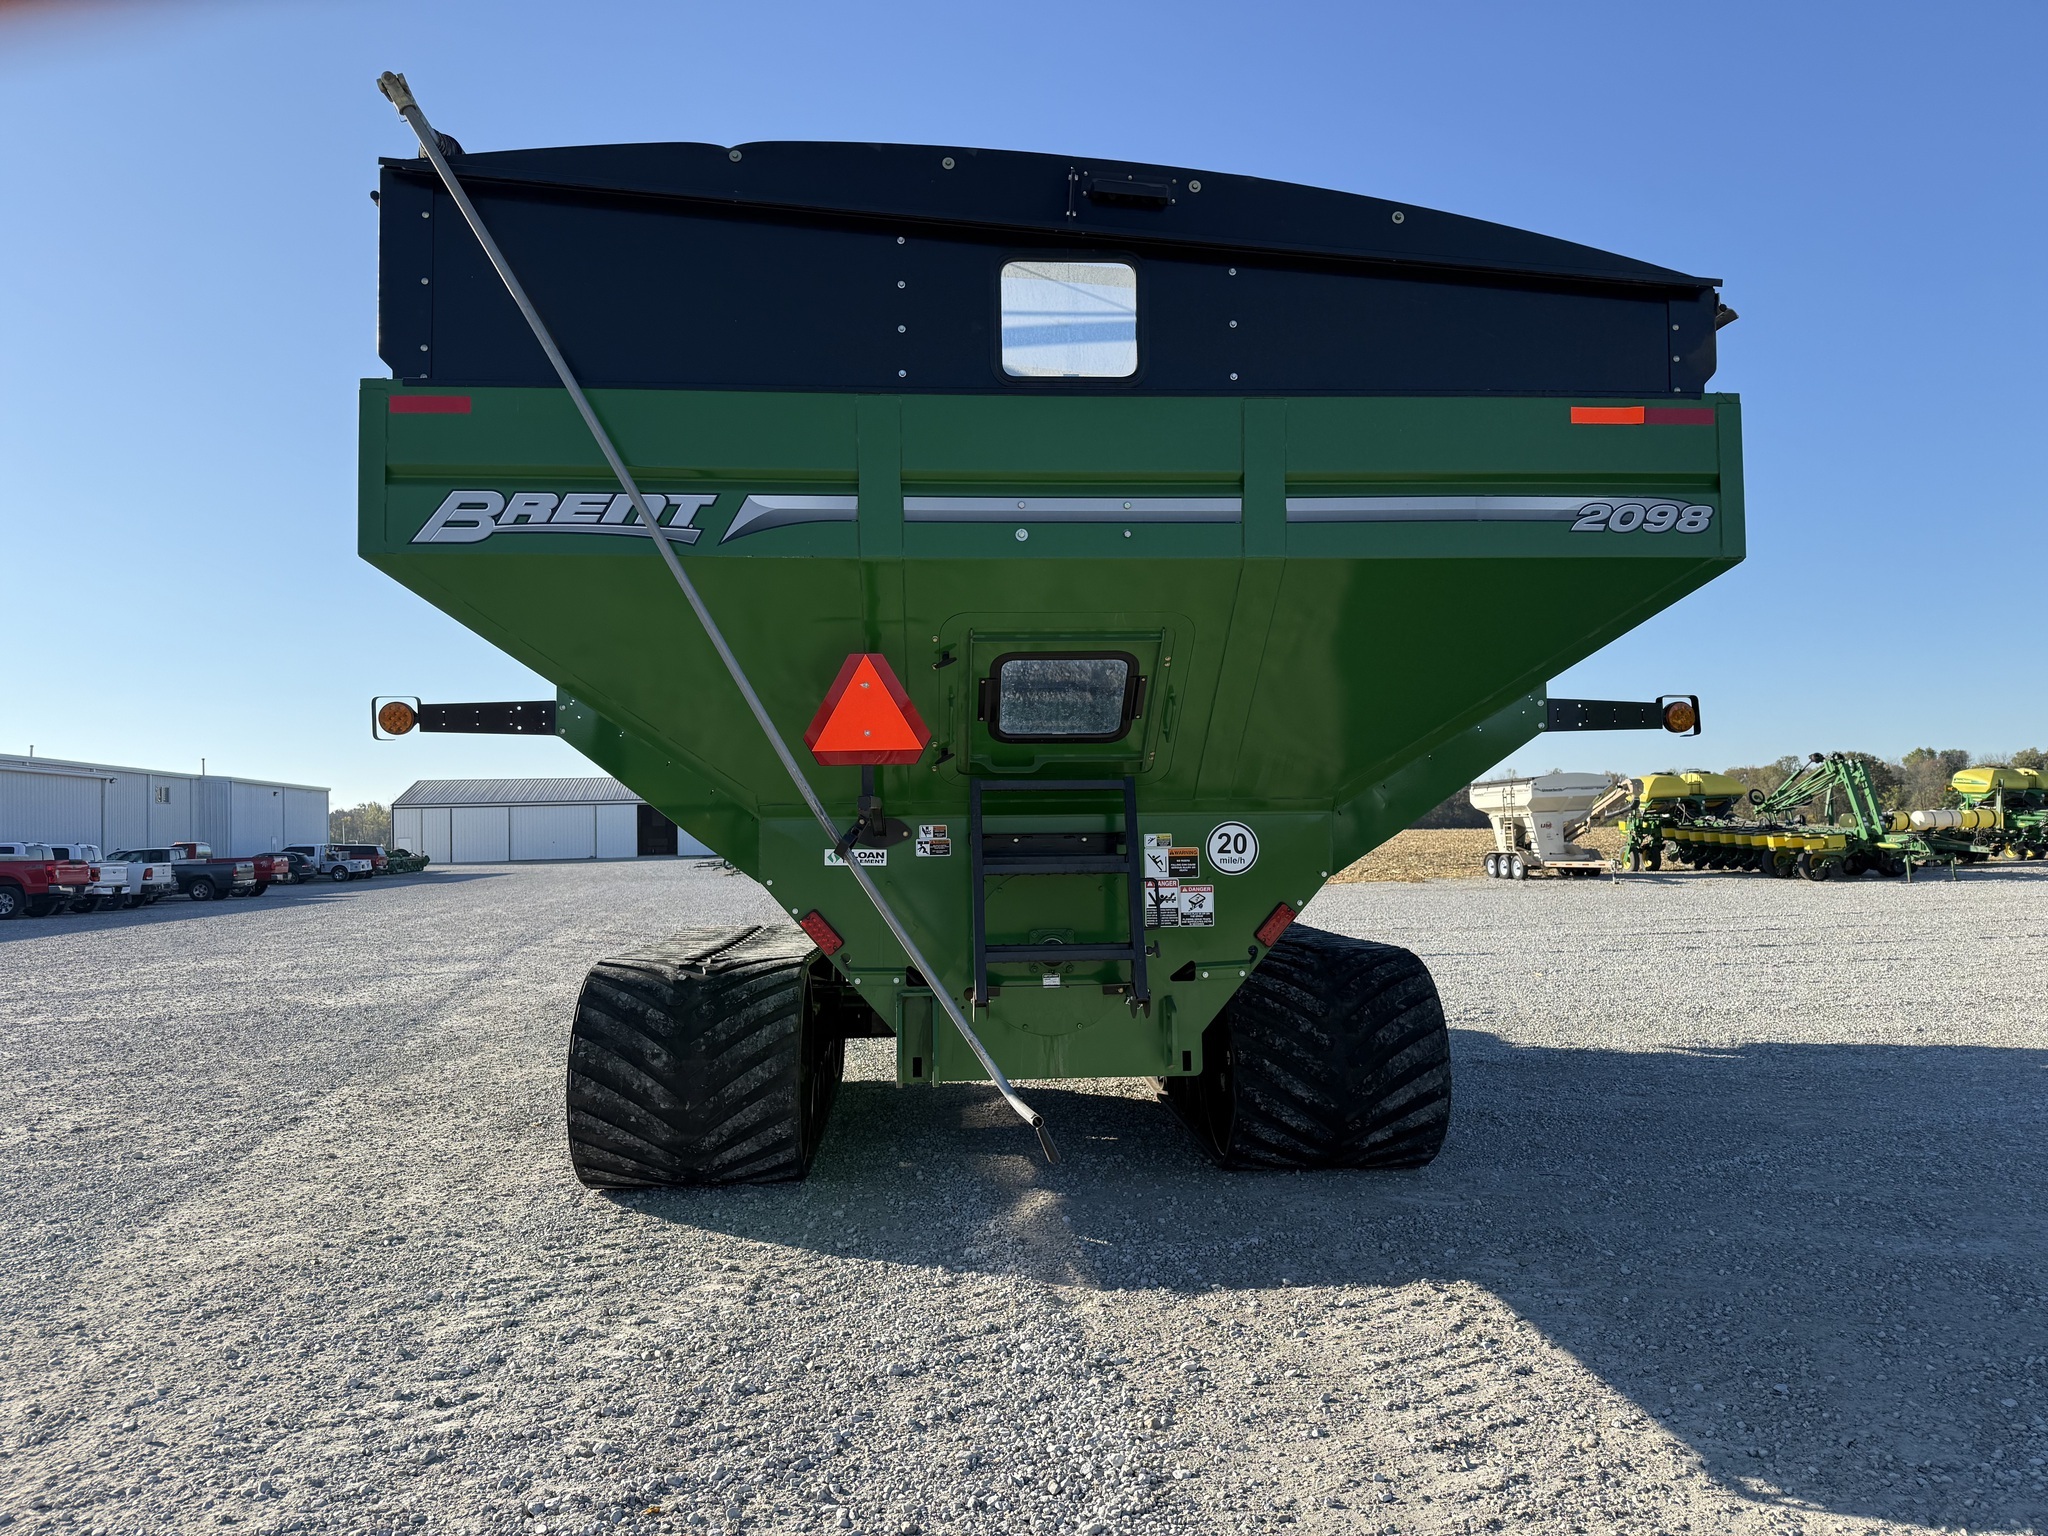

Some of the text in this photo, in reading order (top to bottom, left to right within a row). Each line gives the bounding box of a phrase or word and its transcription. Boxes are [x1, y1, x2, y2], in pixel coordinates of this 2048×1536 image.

[409, 490, 719, 544] BRENT
[1571, 503, 1713, 533] 2098
[1217, 833, 1247, 854] 20
